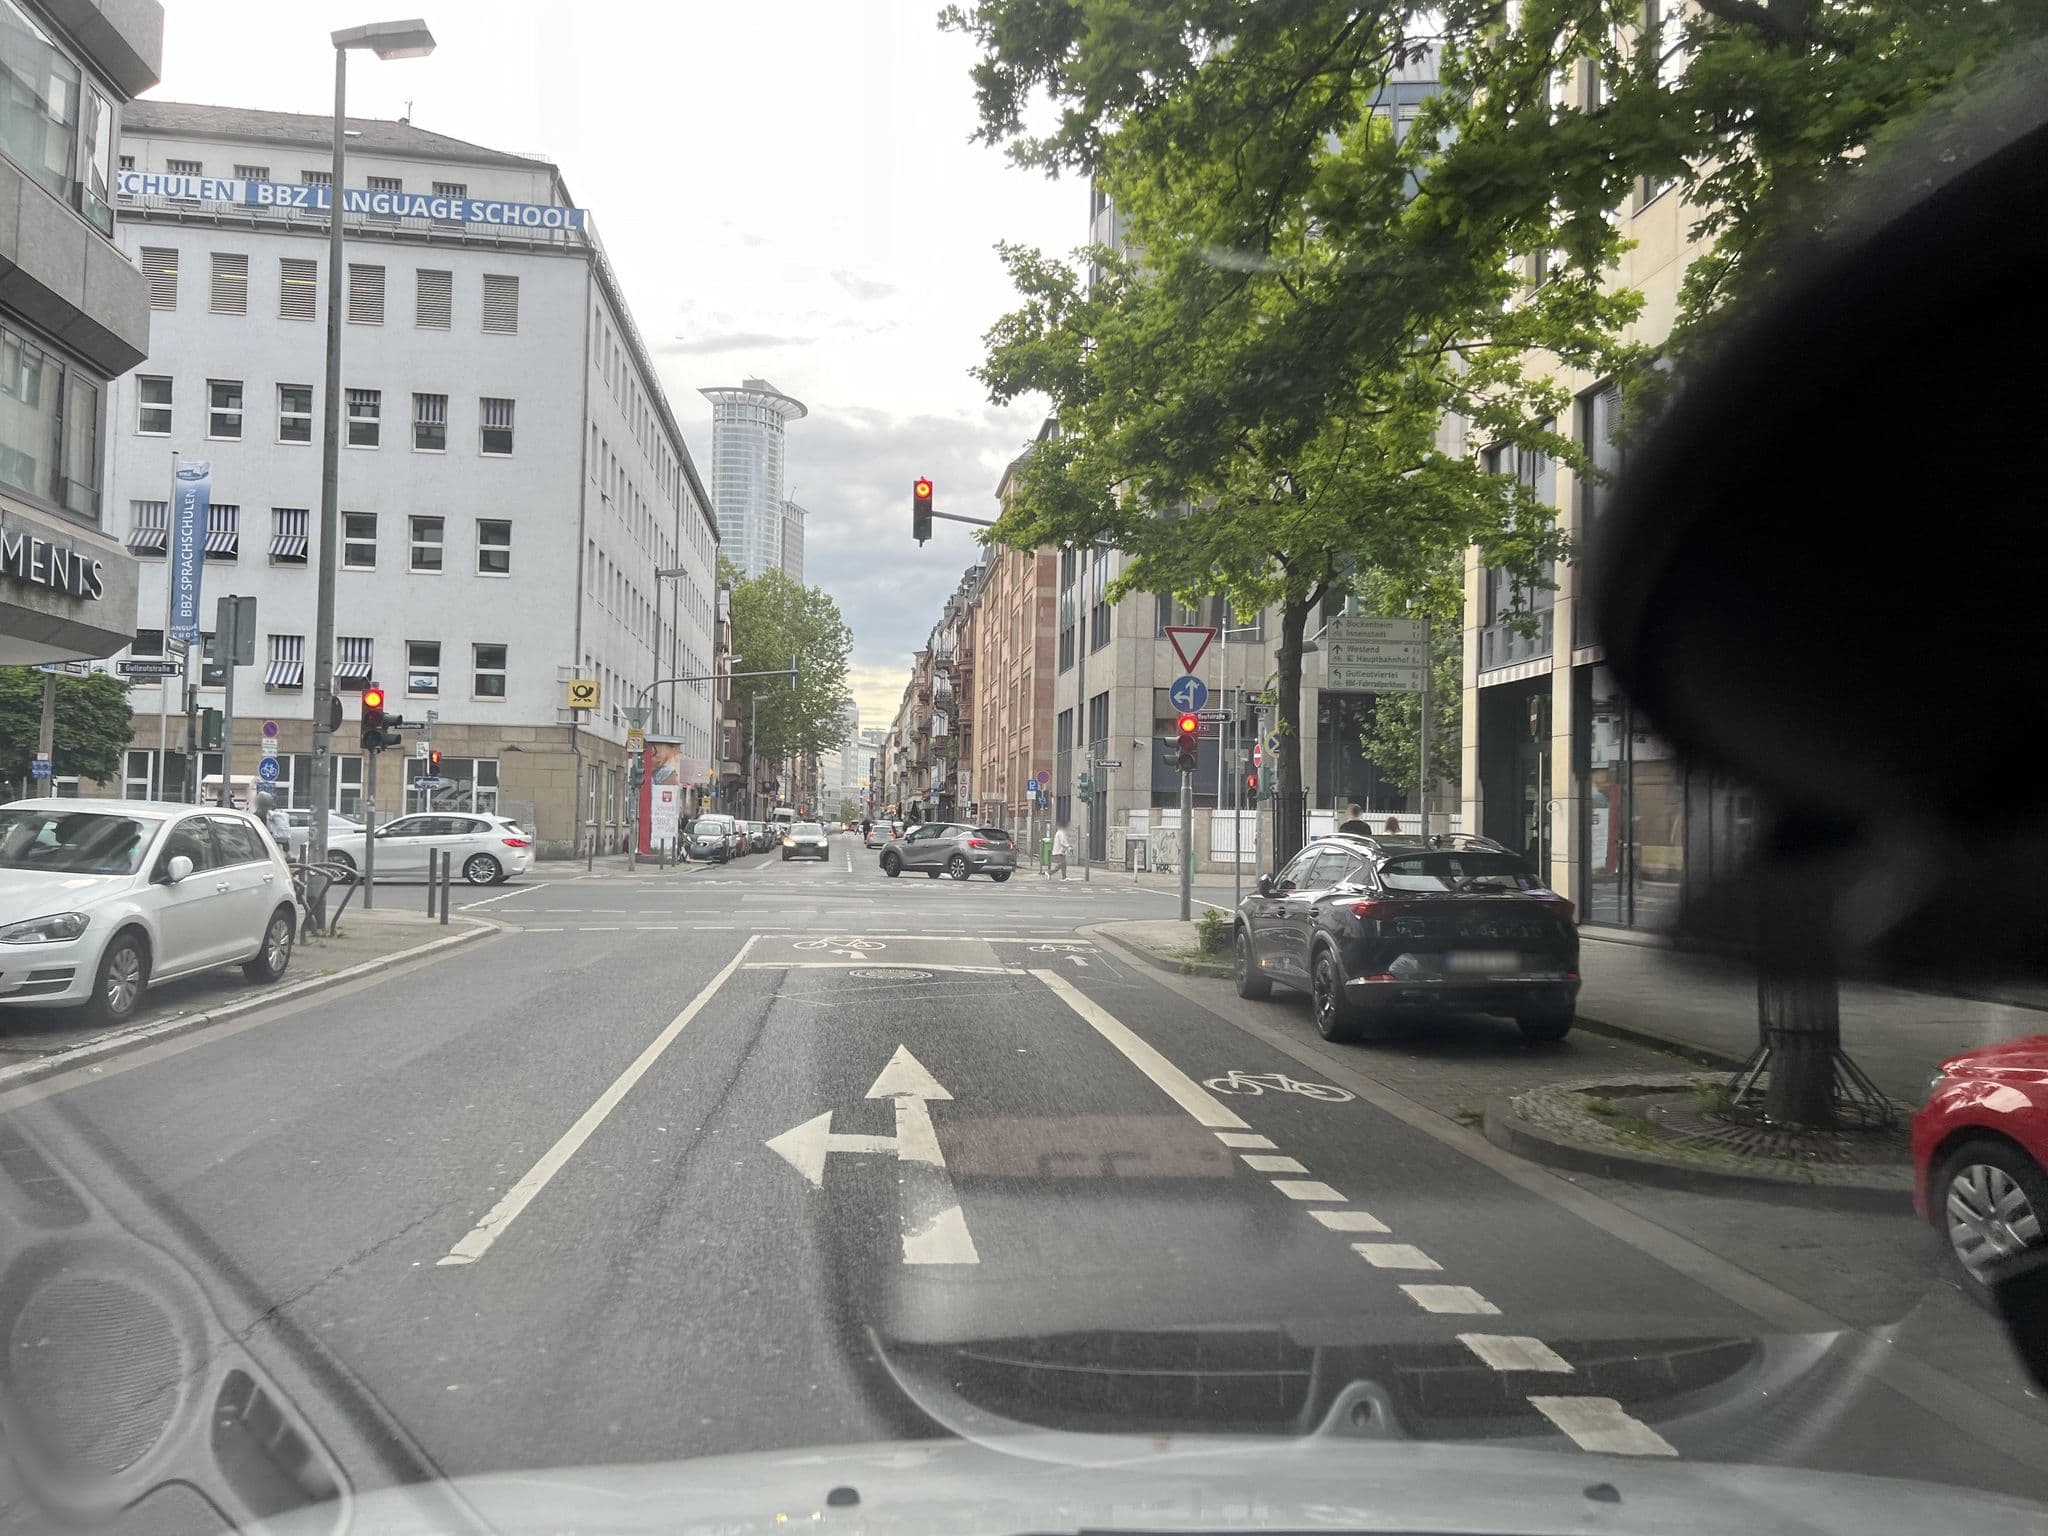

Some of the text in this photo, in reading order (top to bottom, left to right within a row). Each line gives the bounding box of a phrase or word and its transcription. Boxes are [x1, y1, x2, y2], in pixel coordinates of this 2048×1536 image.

[258, 184, 308, 208] BBZ
[471, 201, 577, 230] SCHOOL
[181, 488, 197, 593] SPRACHSCHULEN
[0, 526, 104, 600] MENTS
[181, 596, 193, 617] BBZ
[1346, 645, 1380, 653] Westend
[1356, 655, 1409, 664] Hauptbahnhof
